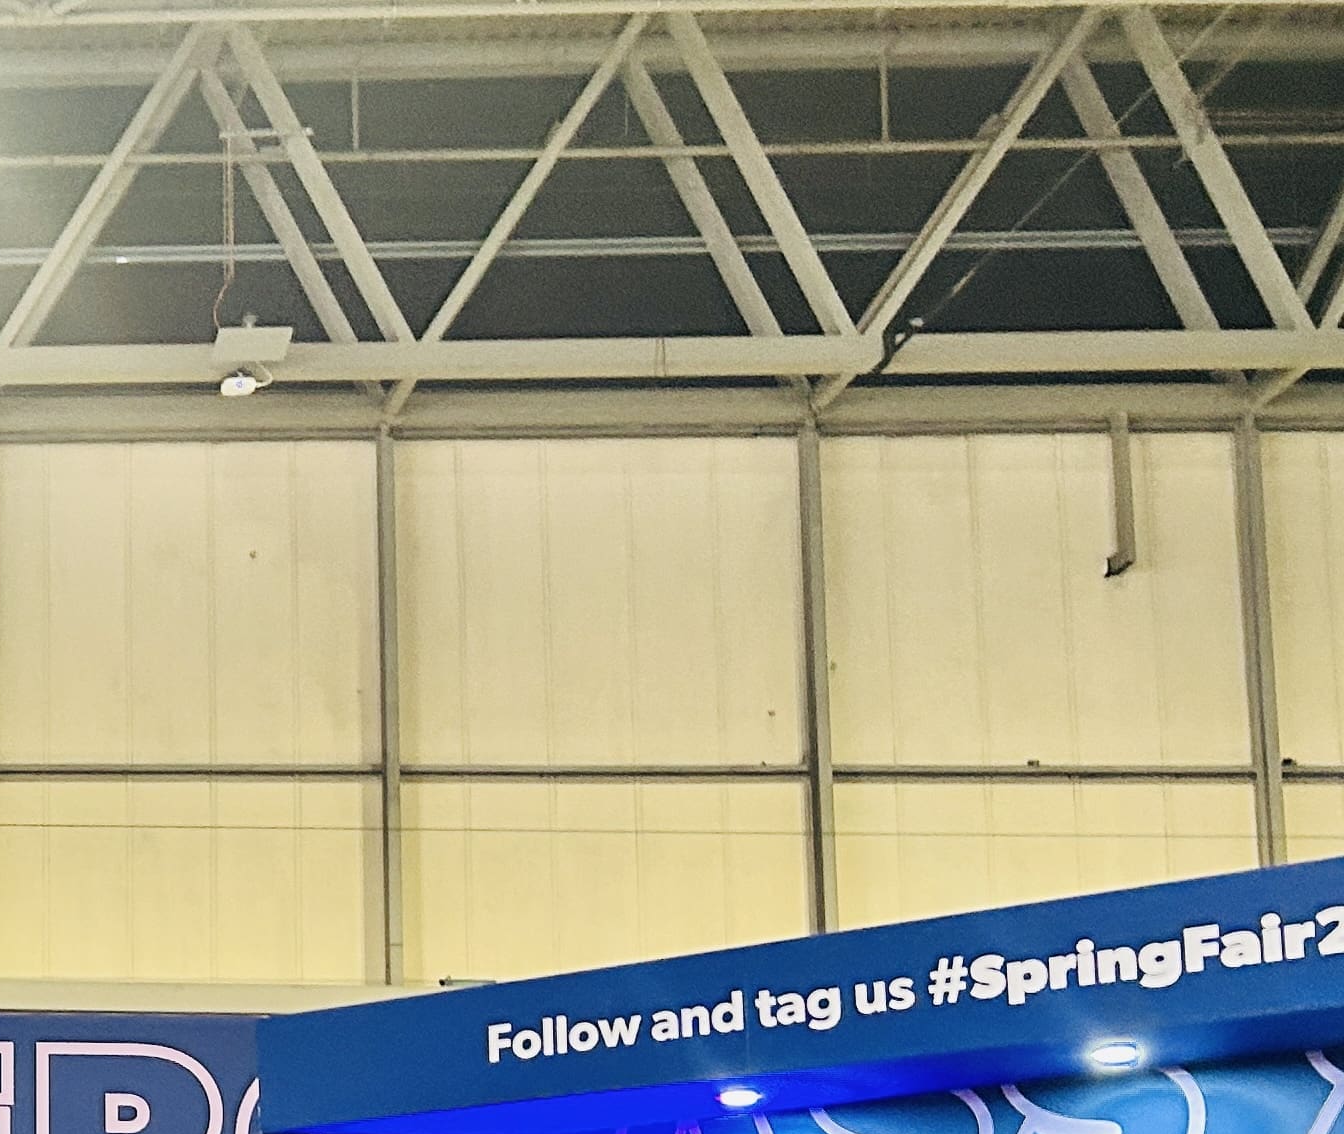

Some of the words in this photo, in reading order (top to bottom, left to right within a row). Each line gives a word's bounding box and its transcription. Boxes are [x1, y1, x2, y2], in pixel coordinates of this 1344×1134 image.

[486, 1012, 642, 1064] Follow
[650, 989, 746, 1042] and
[754, 985, 842, 1031] tag
[853, 974, 917, 1016] us
[927, 904, 1344, 1006] #SpringFair2
